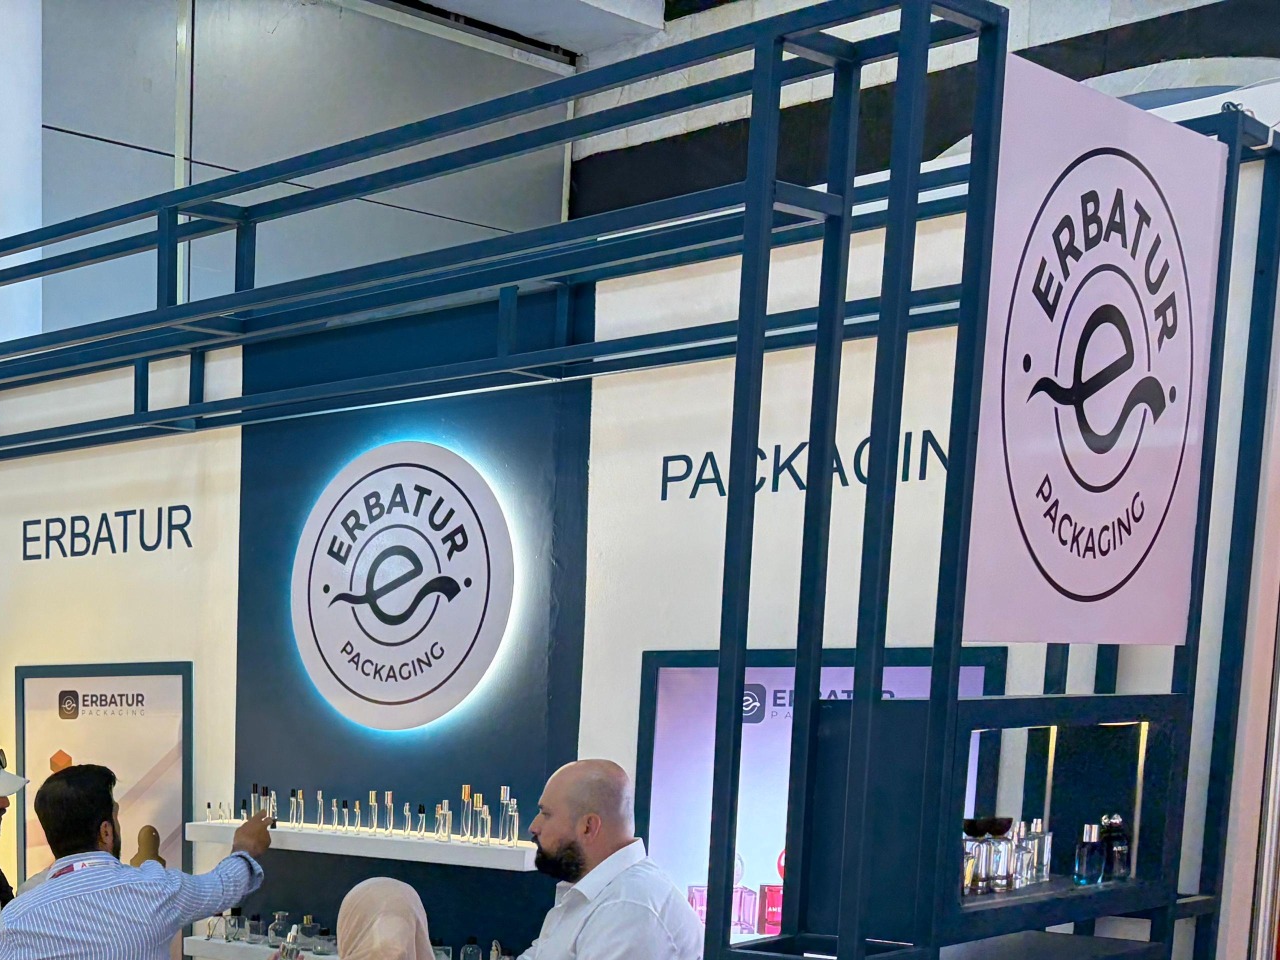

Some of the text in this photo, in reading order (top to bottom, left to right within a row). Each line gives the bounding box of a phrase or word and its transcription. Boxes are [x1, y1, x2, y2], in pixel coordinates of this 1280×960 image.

[1033, 189, 1178, 353] ERBATUR
[23, 505, 192, 560] ERBATUR
[328, 484, 469, 563] ERBATUR
[1036, 474, 1144, 558] PACKAGING
[340, 641, 444, 682] PACKAGING
[82, 693, 145, 707] ERBATUR
[82, 709, 145, 717] PACKAGING
